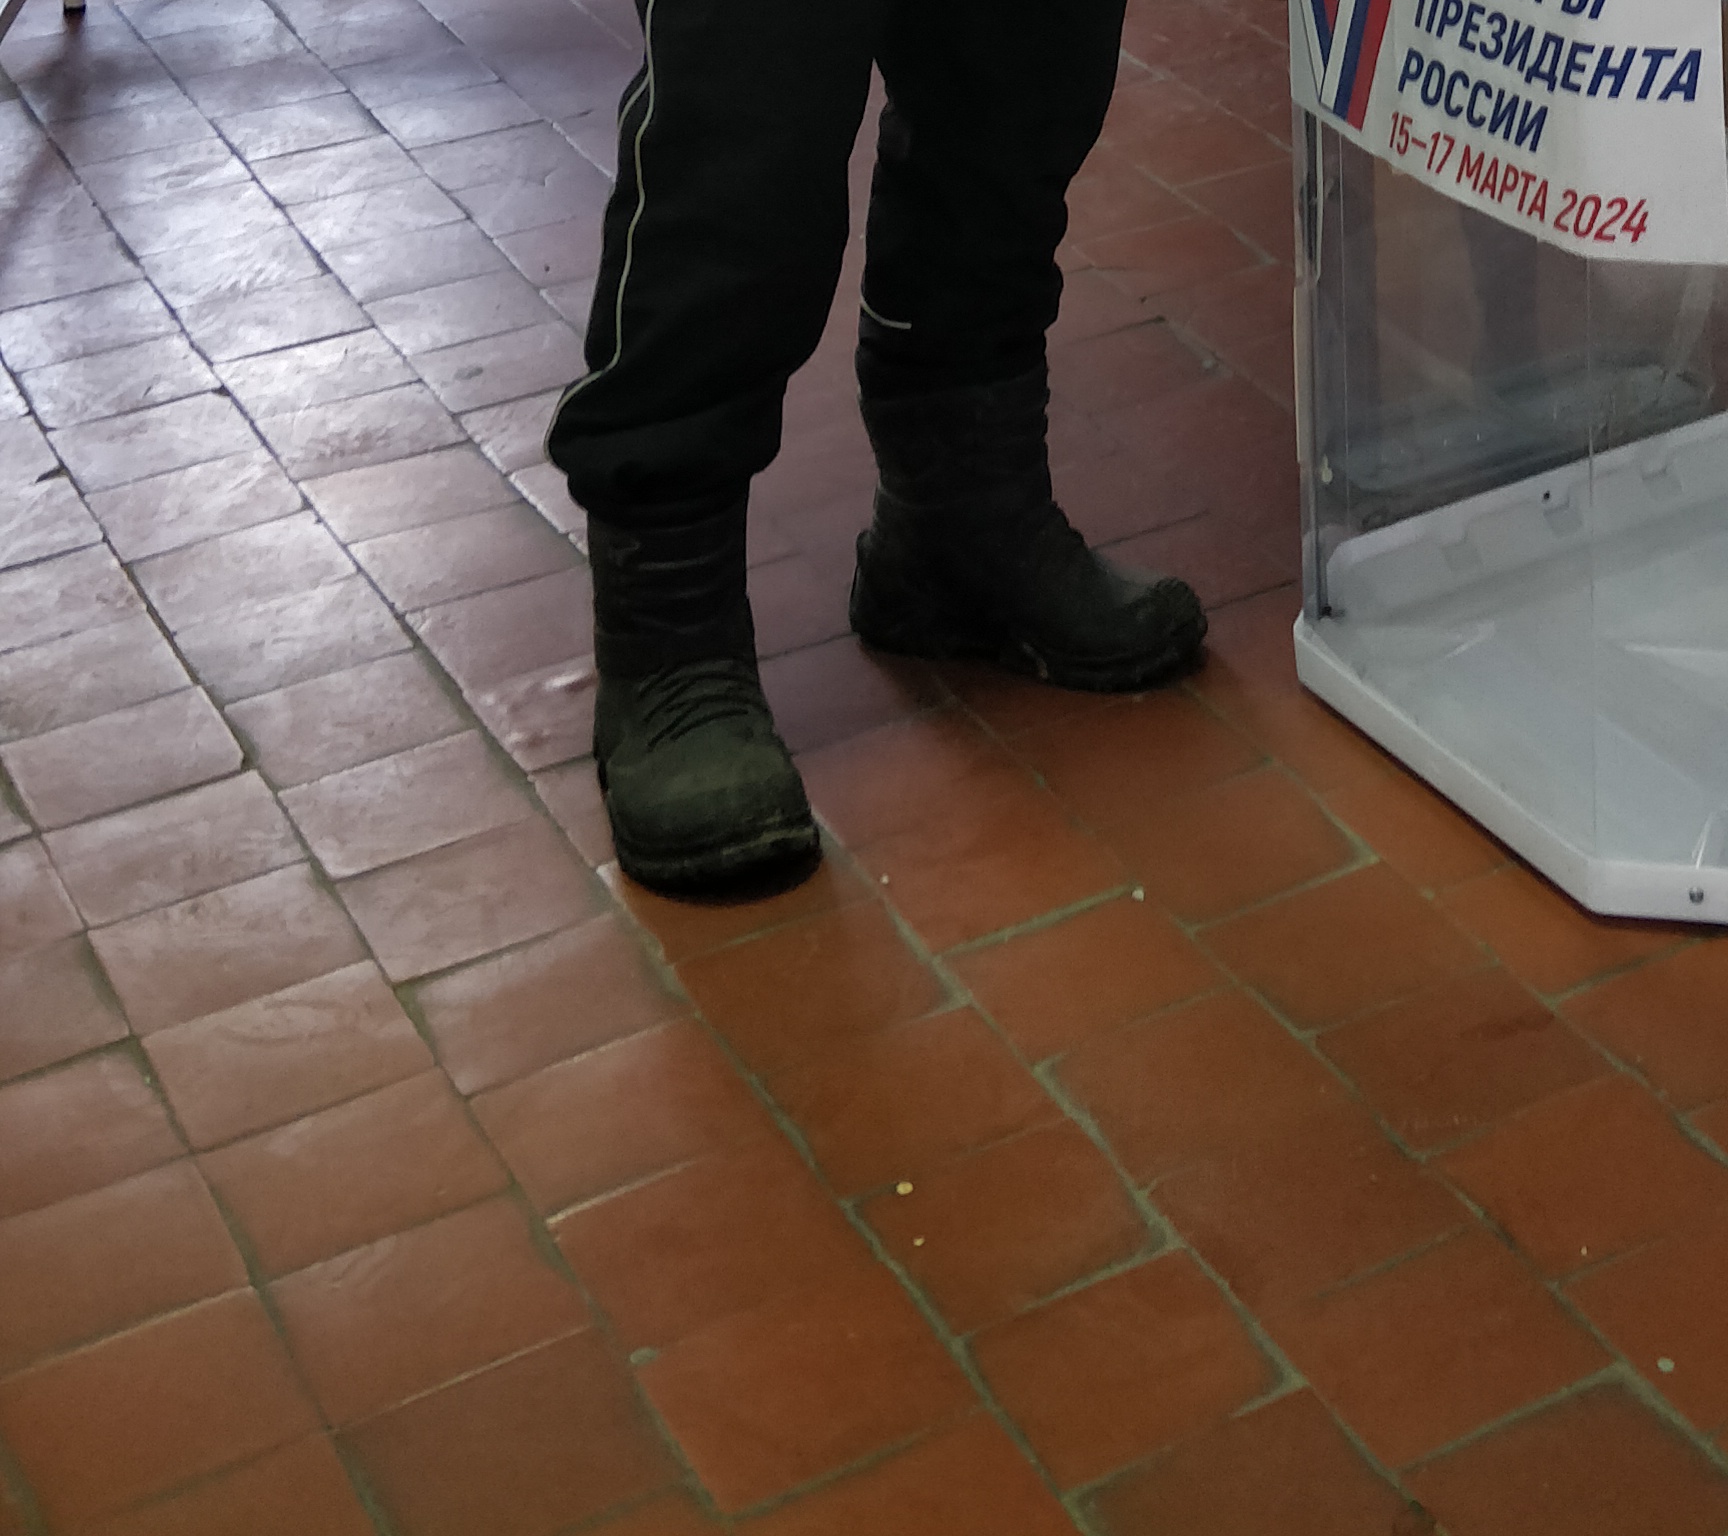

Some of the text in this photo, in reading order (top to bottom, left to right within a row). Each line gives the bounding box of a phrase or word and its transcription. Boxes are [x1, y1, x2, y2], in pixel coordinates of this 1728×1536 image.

[1397, 47, 1549, 152] РОССИИ
[1456, 143, 1549, 222] МАРТА
[1552, 189, 1650, 244] 2024
